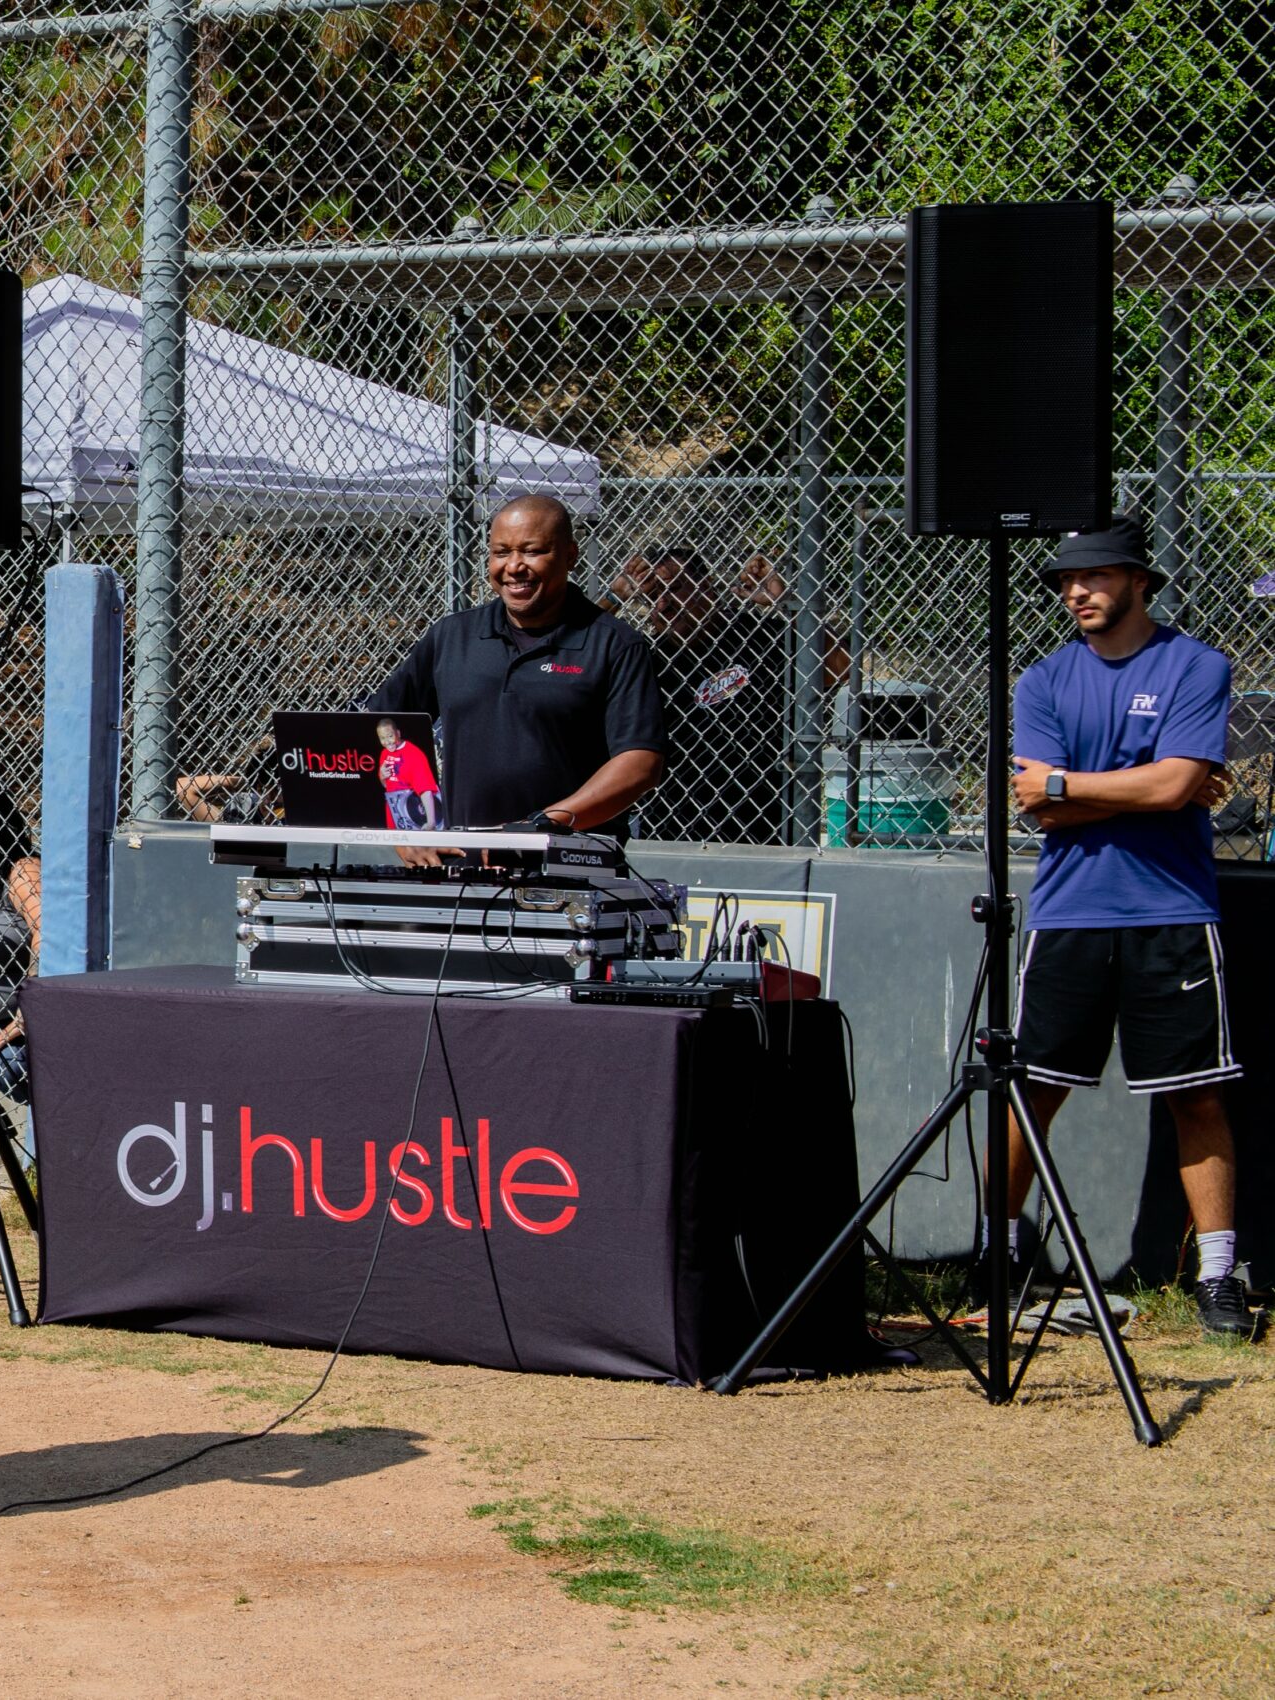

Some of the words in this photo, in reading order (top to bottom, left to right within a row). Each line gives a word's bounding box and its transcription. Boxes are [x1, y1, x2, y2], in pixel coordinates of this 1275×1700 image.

[1000, 513, 1031, 521] QSC
[282, 747, 375, 774] dj.hustle
[117, 1101, 580, 1235] dj.hustle
